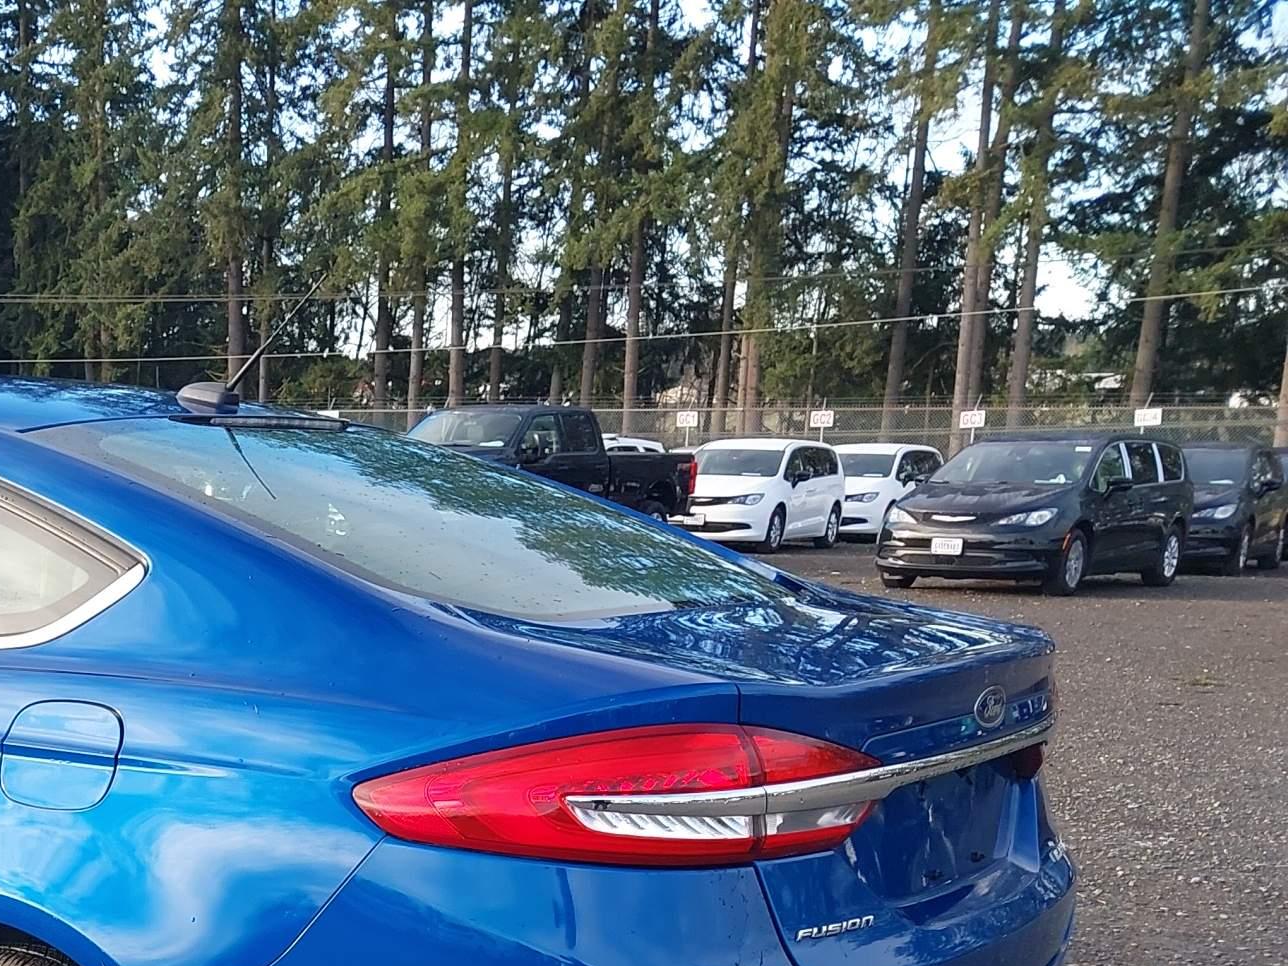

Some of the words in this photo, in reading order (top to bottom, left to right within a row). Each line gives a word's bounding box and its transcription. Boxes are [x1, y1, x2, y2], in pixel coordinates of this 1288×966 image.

[679, 413, 696, 425] GC1
[813, 413, 832, 425] GC2
[795, 914, 874, 942] FUSION
